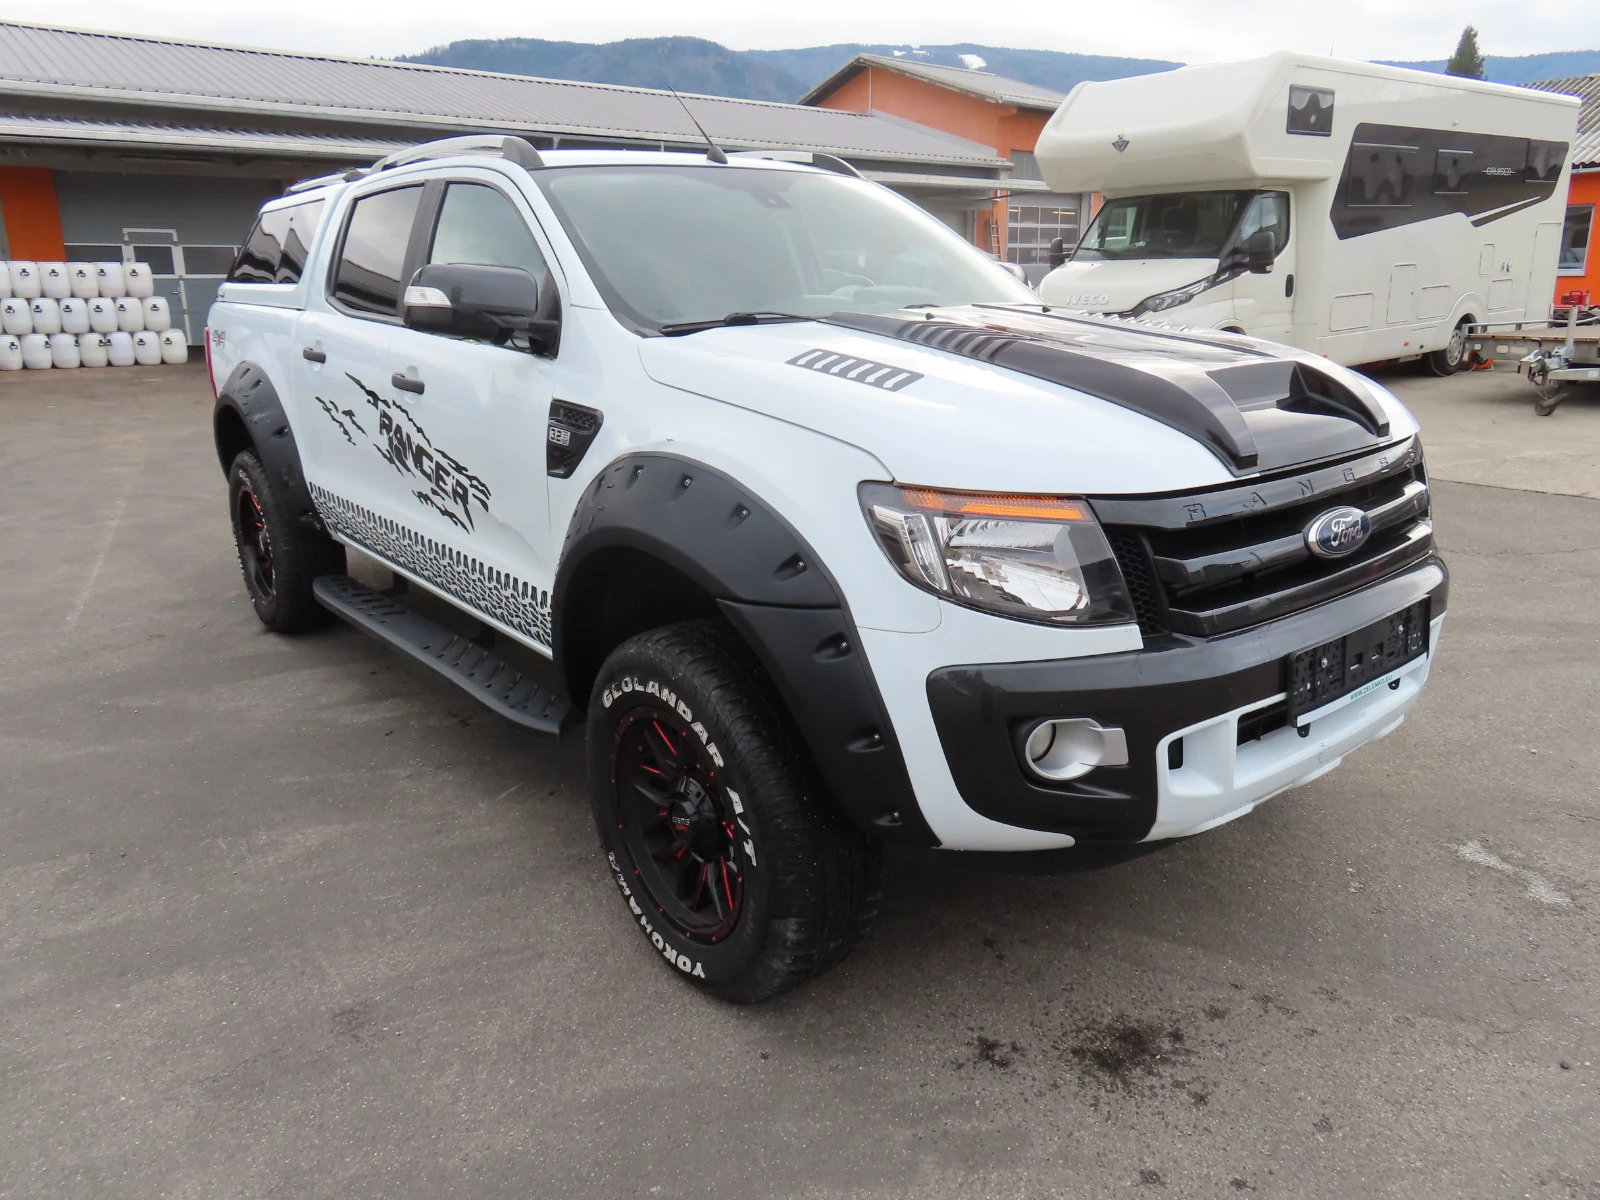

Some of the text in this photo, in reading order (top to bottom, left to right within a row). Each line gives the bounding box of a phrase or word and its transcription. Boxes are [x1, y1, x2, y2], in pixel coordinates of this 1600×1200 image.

[1065, 293, 1111, 306] IVECO
[379, 407, 474, 532] RANGER
[1330, 515, 1363, 547] Ford
[601, 675, 725, 768] GEOLANDAR
[725, 786, 757, 867] A/T
[608, 850, 706, 979] YOKOHAMA
